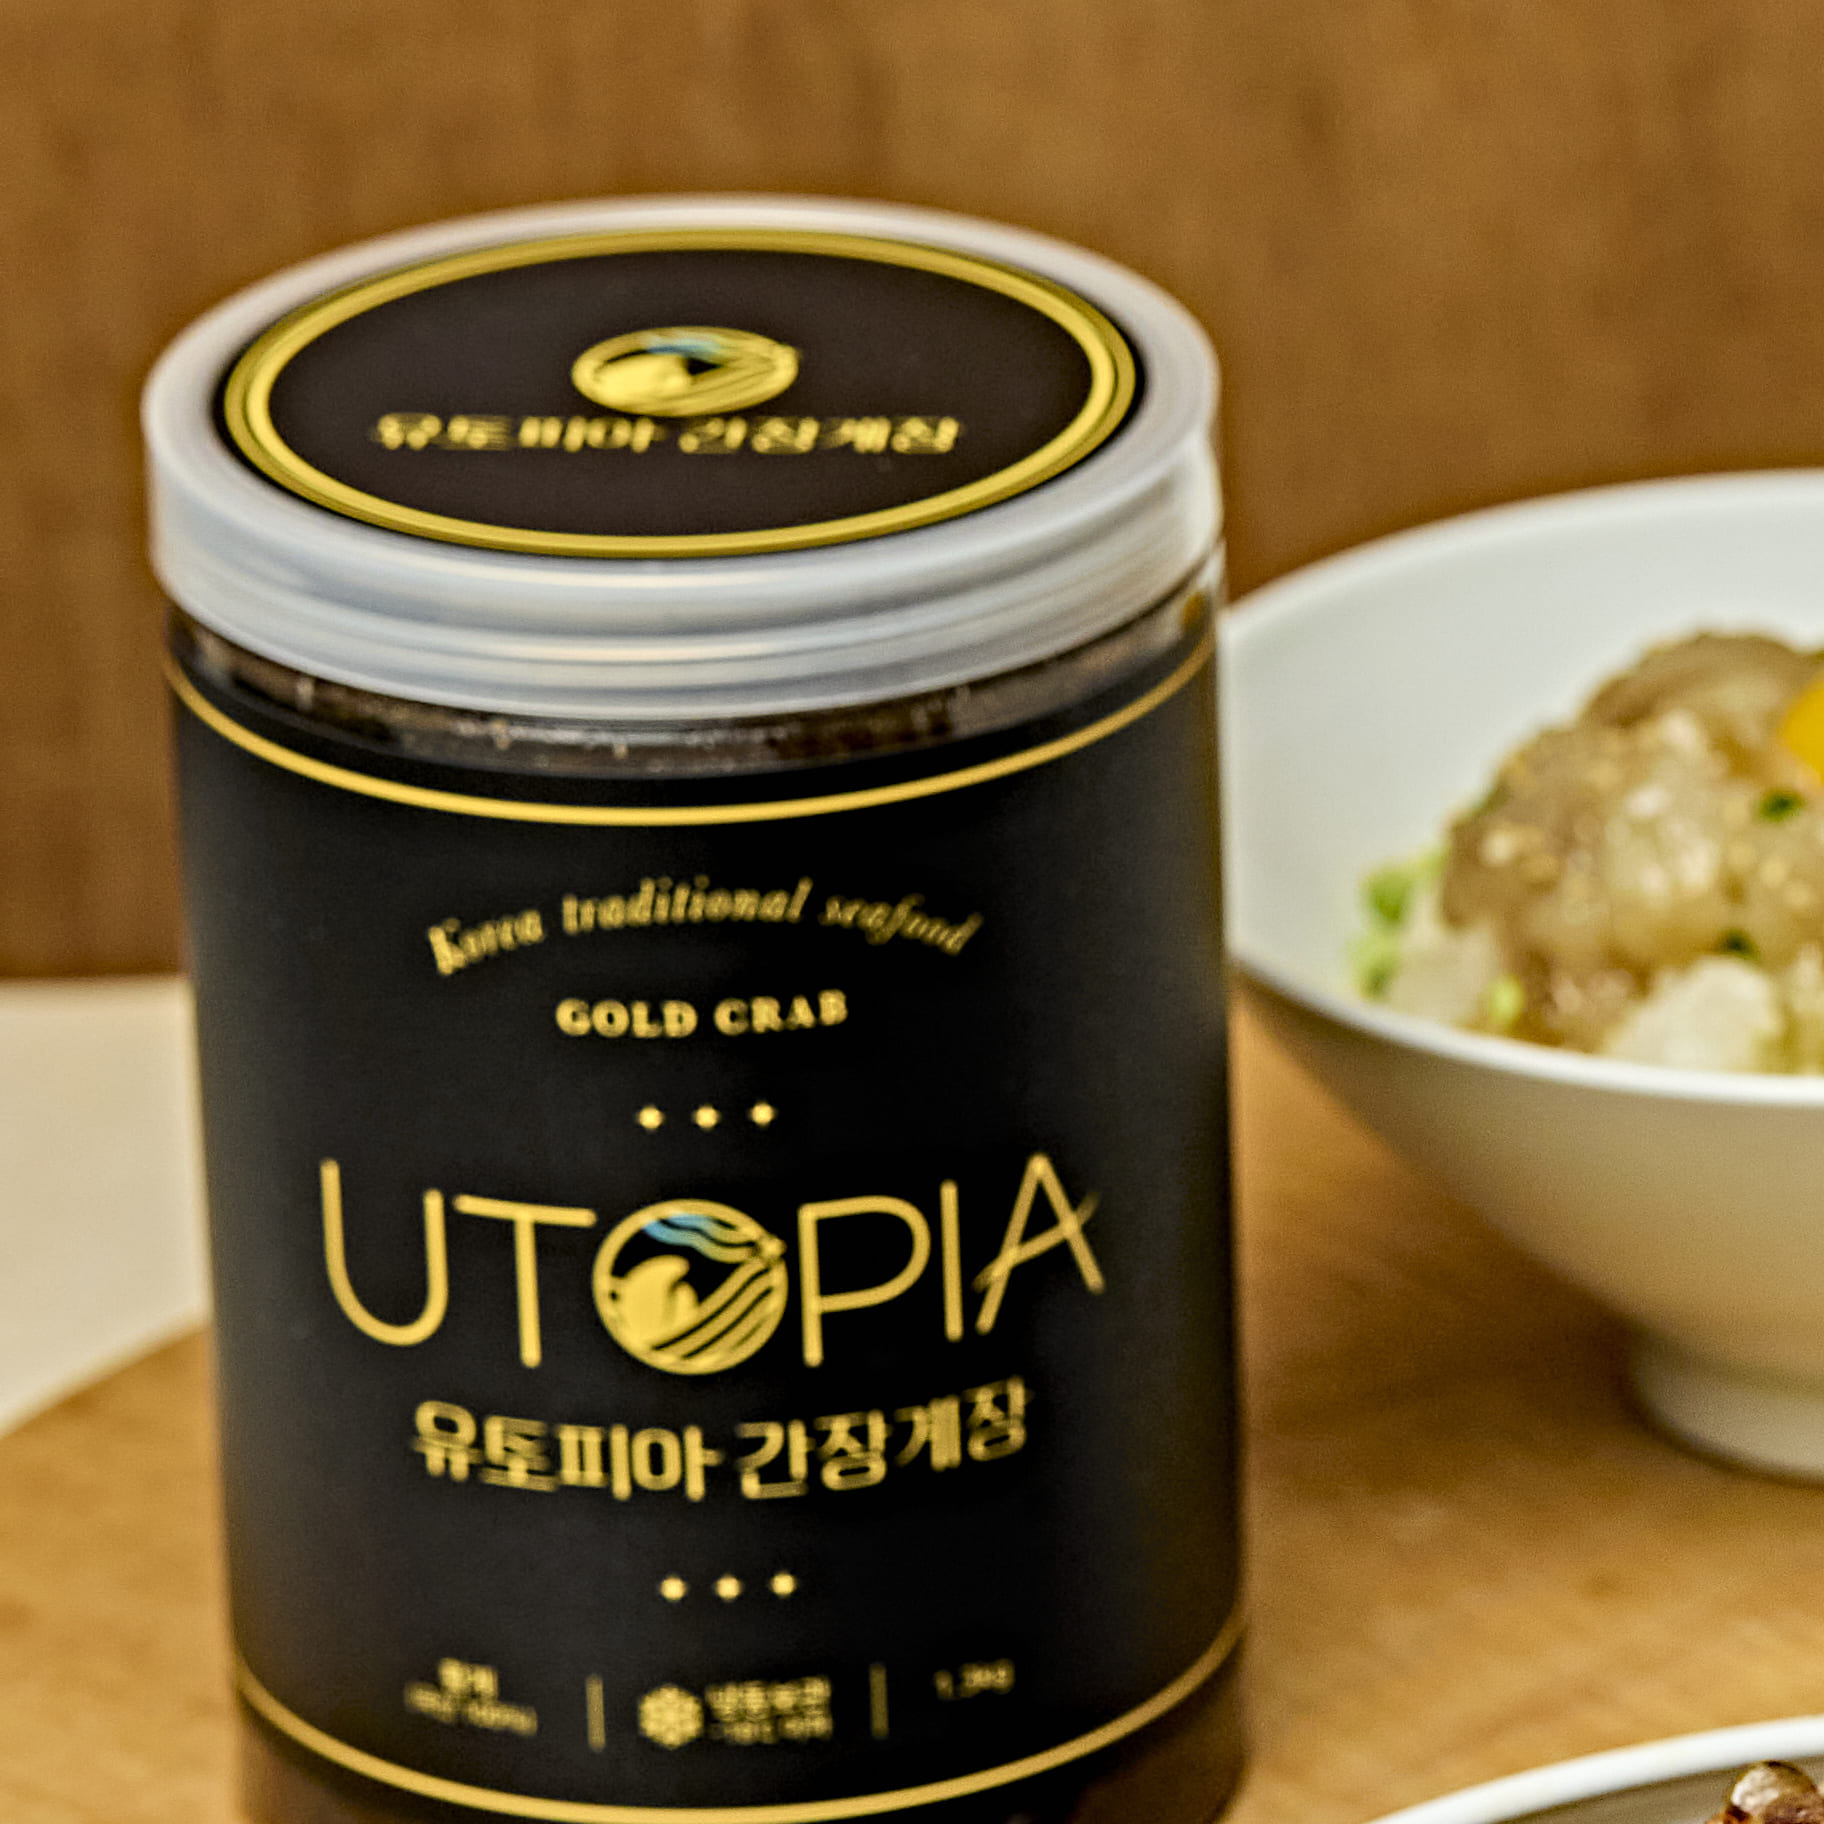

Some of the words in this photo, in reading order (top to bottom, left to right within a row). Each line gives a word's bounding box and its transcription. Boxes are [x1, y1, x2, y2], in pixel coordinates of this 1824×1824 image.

[372, 412, 662, 454] 유토피아
[428, 914, 543, 975] Korea
[562, 875, 813, 936] traditional
[820, 894, 983, 955] seafood
[555, 998, 698, 1038] GOLD
[713, 988, 848, 1036] CRAB
[320, 1153, 1105, 1375] UTOPIA
[413, 1398, 722, 1502] 유토피아
[734, 1376, 1030, 1502] 간장게장
